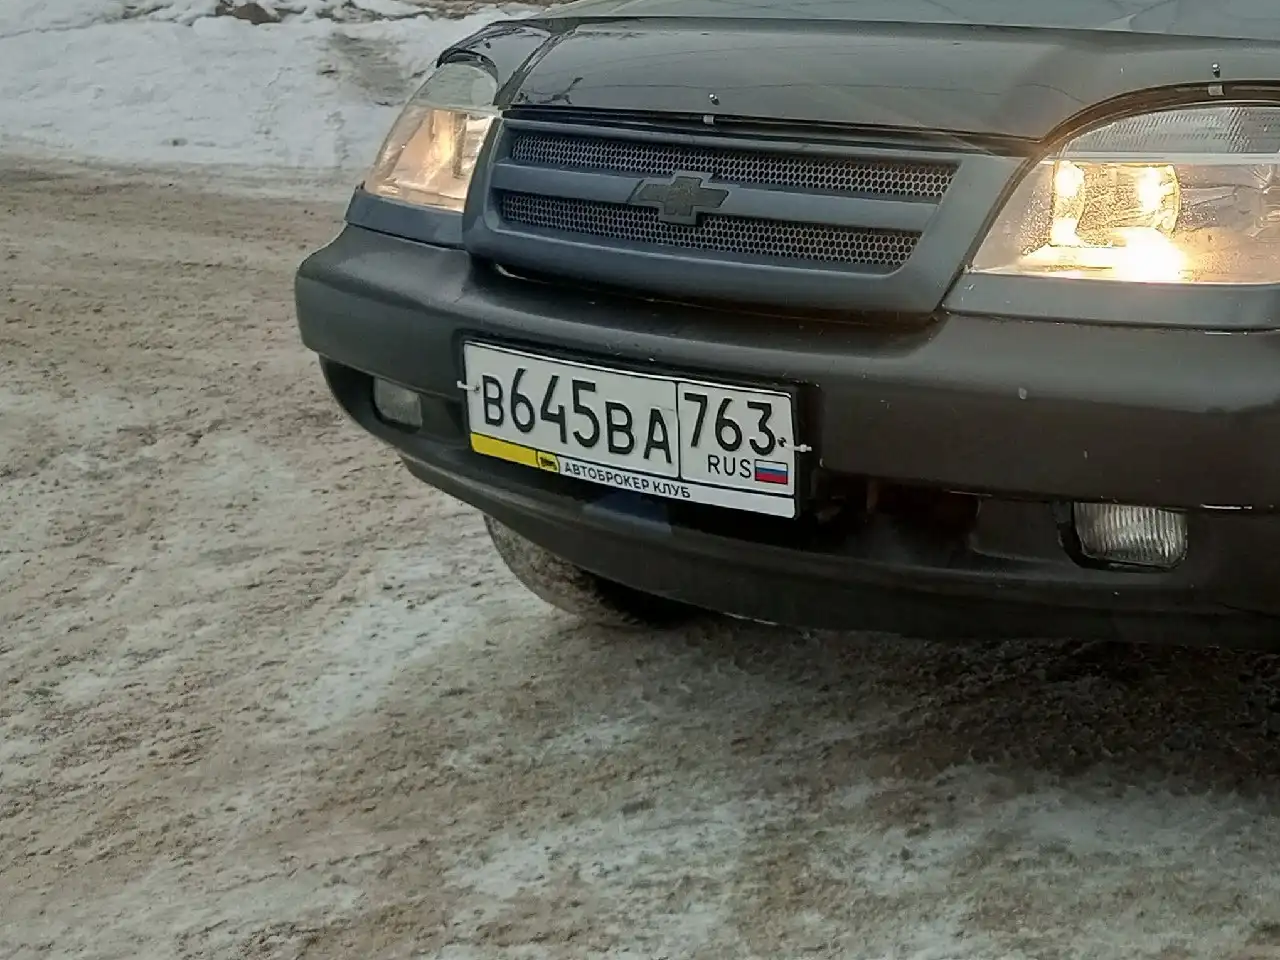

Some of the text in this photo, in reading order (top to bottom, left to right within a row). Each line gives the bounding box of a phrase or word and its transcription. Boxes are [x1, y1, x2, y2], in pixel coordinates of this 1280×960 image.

[683, 392, 777, 456] 763
[564, 462, 691, 499] АВТОБРОКЕР КЛУБ
[707, 453, 752, 478] RUS
